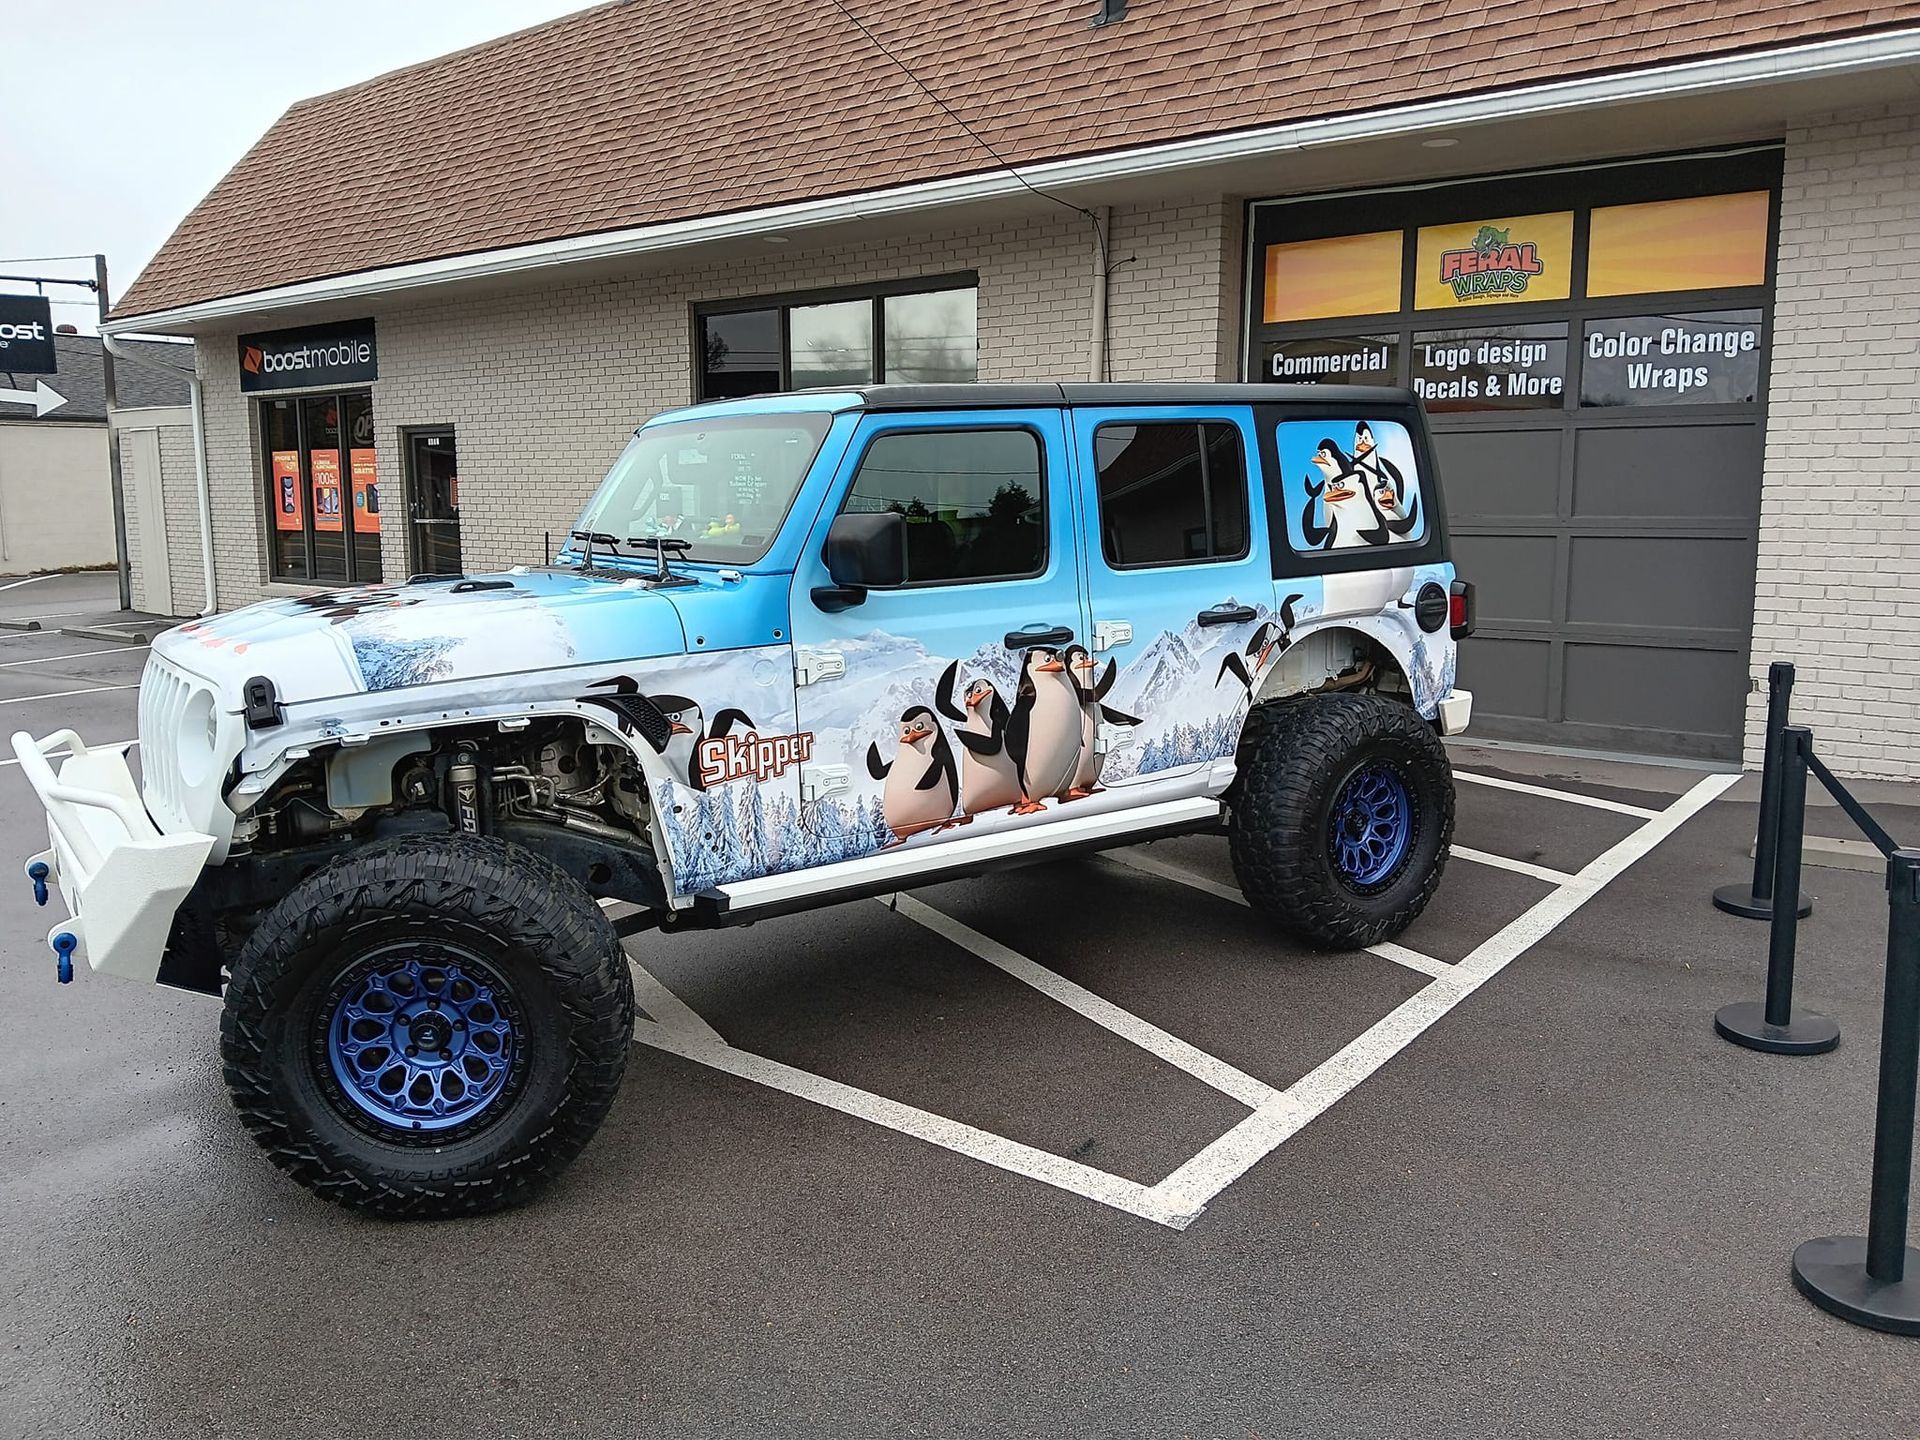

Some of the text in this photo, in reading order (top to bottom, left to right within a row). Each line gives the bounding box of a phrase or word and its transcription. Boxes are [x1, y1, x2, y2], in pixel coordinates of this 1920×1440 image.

[1442, 243, 1541, 281] FERAL
[1453, 271, 1527, 295] WRAPS
[1424, 340, 1548, 371] Logo design
[1589, 328, 1755, 358] Color Change
[1272, 346, 1388, 376] Commercial
[1413, 373, 1562, 399] Decals & More
[1627, 363, 1708, 393] Wraps
[699, 731, 815, 786] Skipper
